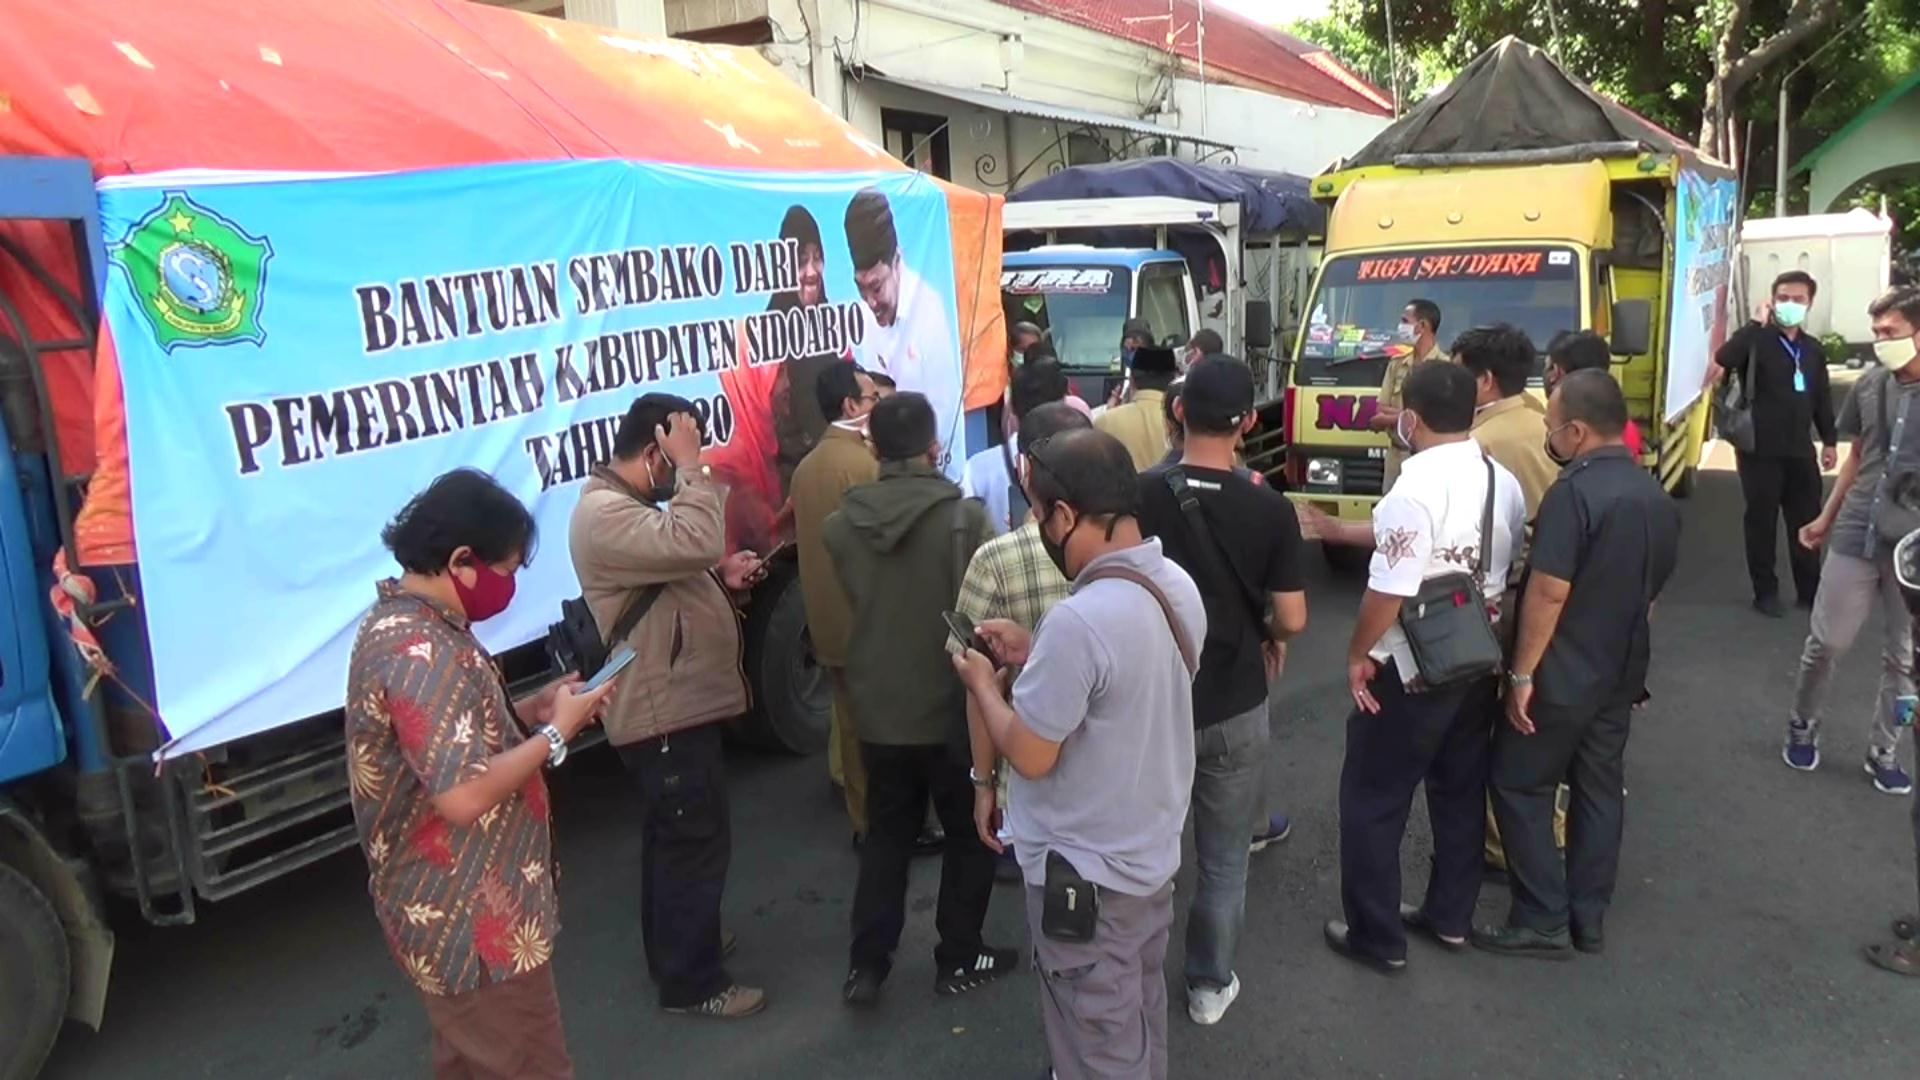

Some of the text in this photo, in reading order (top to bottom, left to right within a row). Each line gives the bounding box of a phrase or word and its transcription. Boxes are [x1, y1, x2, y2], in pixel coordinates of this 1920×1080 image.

[358, 239, 800, 352] BANTUAN SEMBAKO DARI
[1357, 256, 1415, 281] TIGA
[225, 302, 865, 474] PEMERINTAH KABUPATEN SIDOARJO
[526, 413, 627, 492] TAHU
